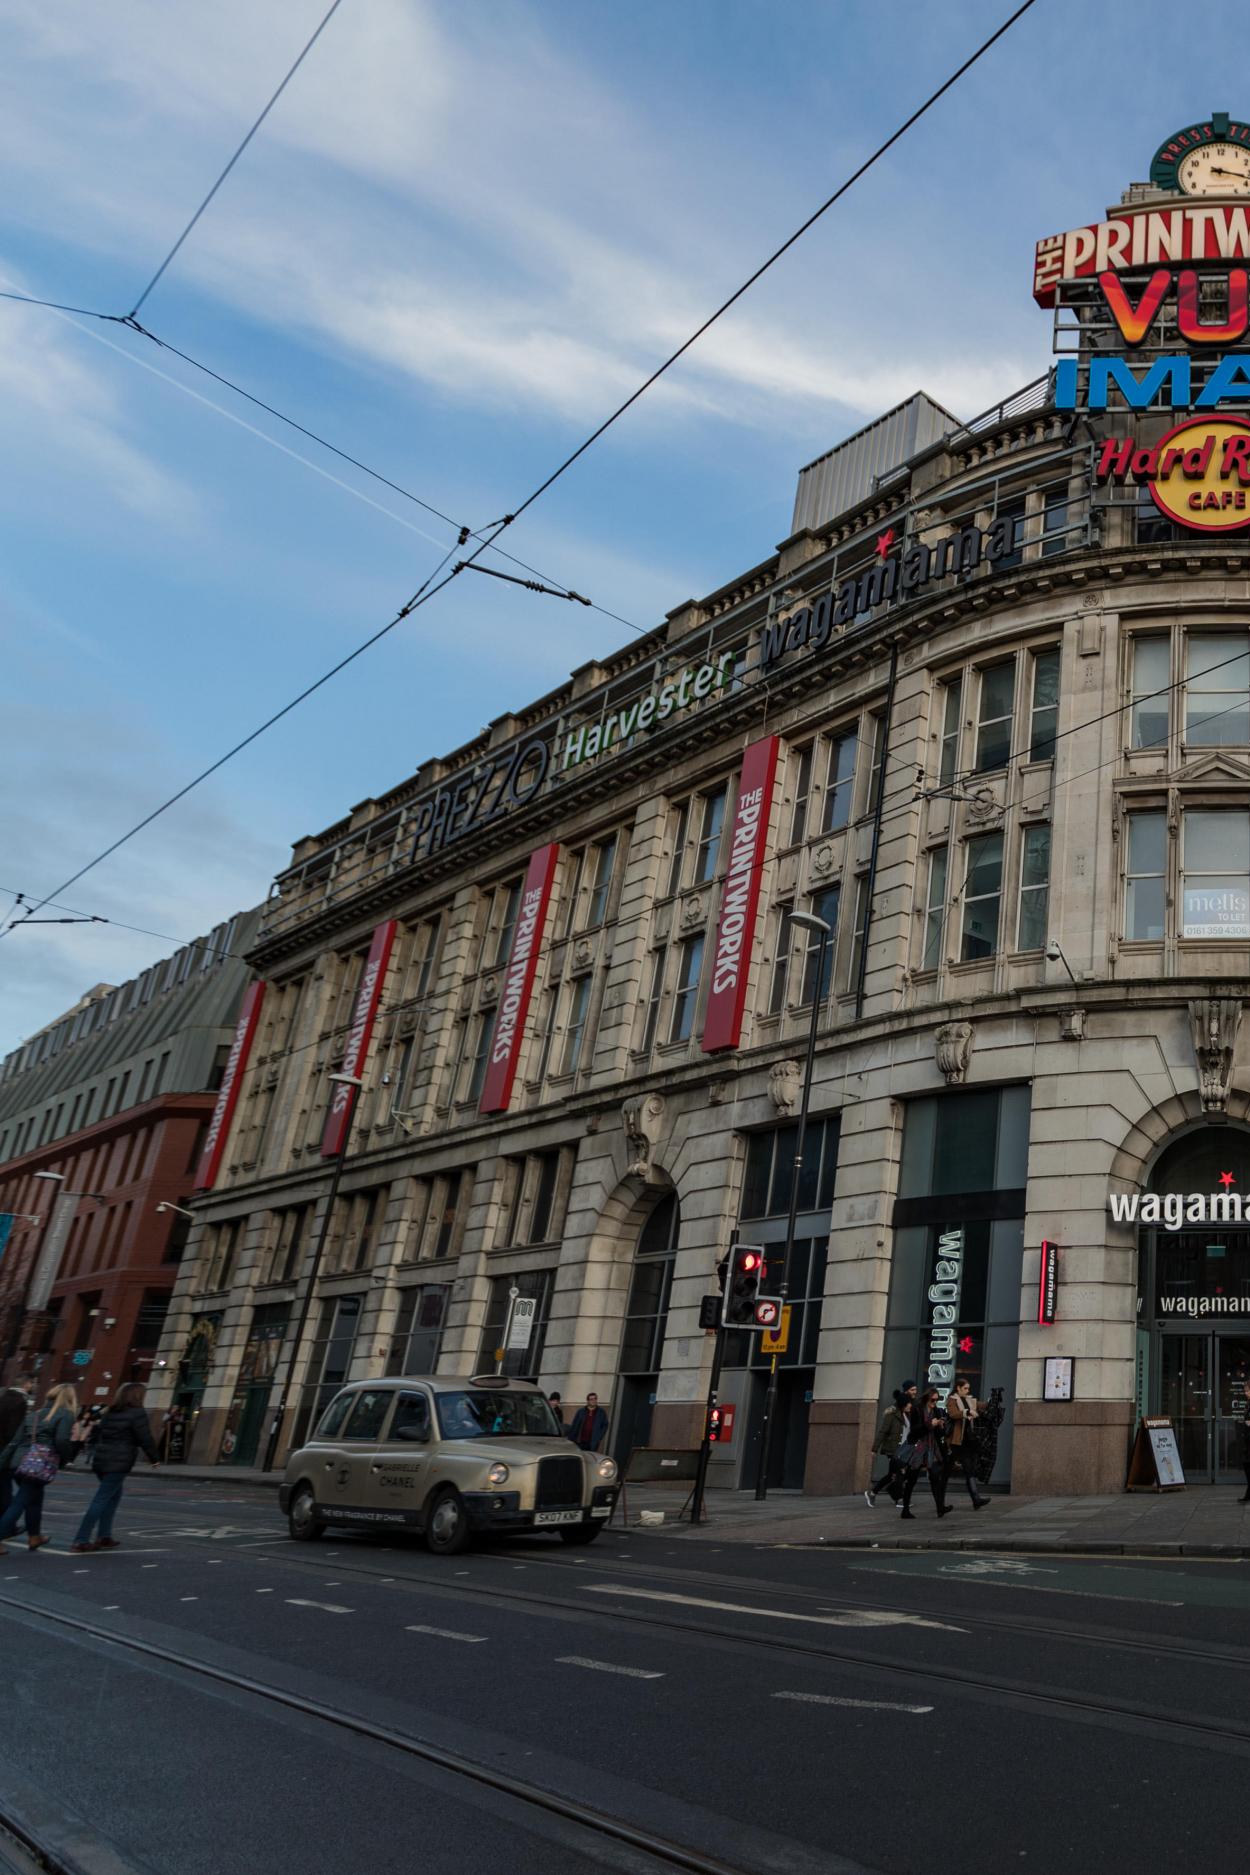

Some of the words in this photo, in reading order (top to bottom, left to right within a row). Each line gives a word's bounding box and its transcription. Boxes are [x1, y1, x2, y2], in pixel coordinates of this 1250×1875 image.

[1161, 125, 1213, 161] PRESS
[1036, 233, 1064, 292] THE
[1096, 436, 1217, 482] Hard
[1188, 491, 1246, 510] CAFE
[761, 516, 1015, 666] wagamama
[563, 650, 734, 770] Harvester
[740, 787, 763, 809] THE
[525, 887, 542, 905] THE
[713, 803, 760, 994] PRINTWORKS
[1218, 912, 1230, 921] TO
[1231, 912, 1246, 921] LET
[493, 903, 538, 1063] PRINTWORKS
[333, 972, 376, 1114] PRINTWOKS
[1047, 1248, 1056, 1317] wagamama
[380, 1476, 415, 1489] CHANEL
